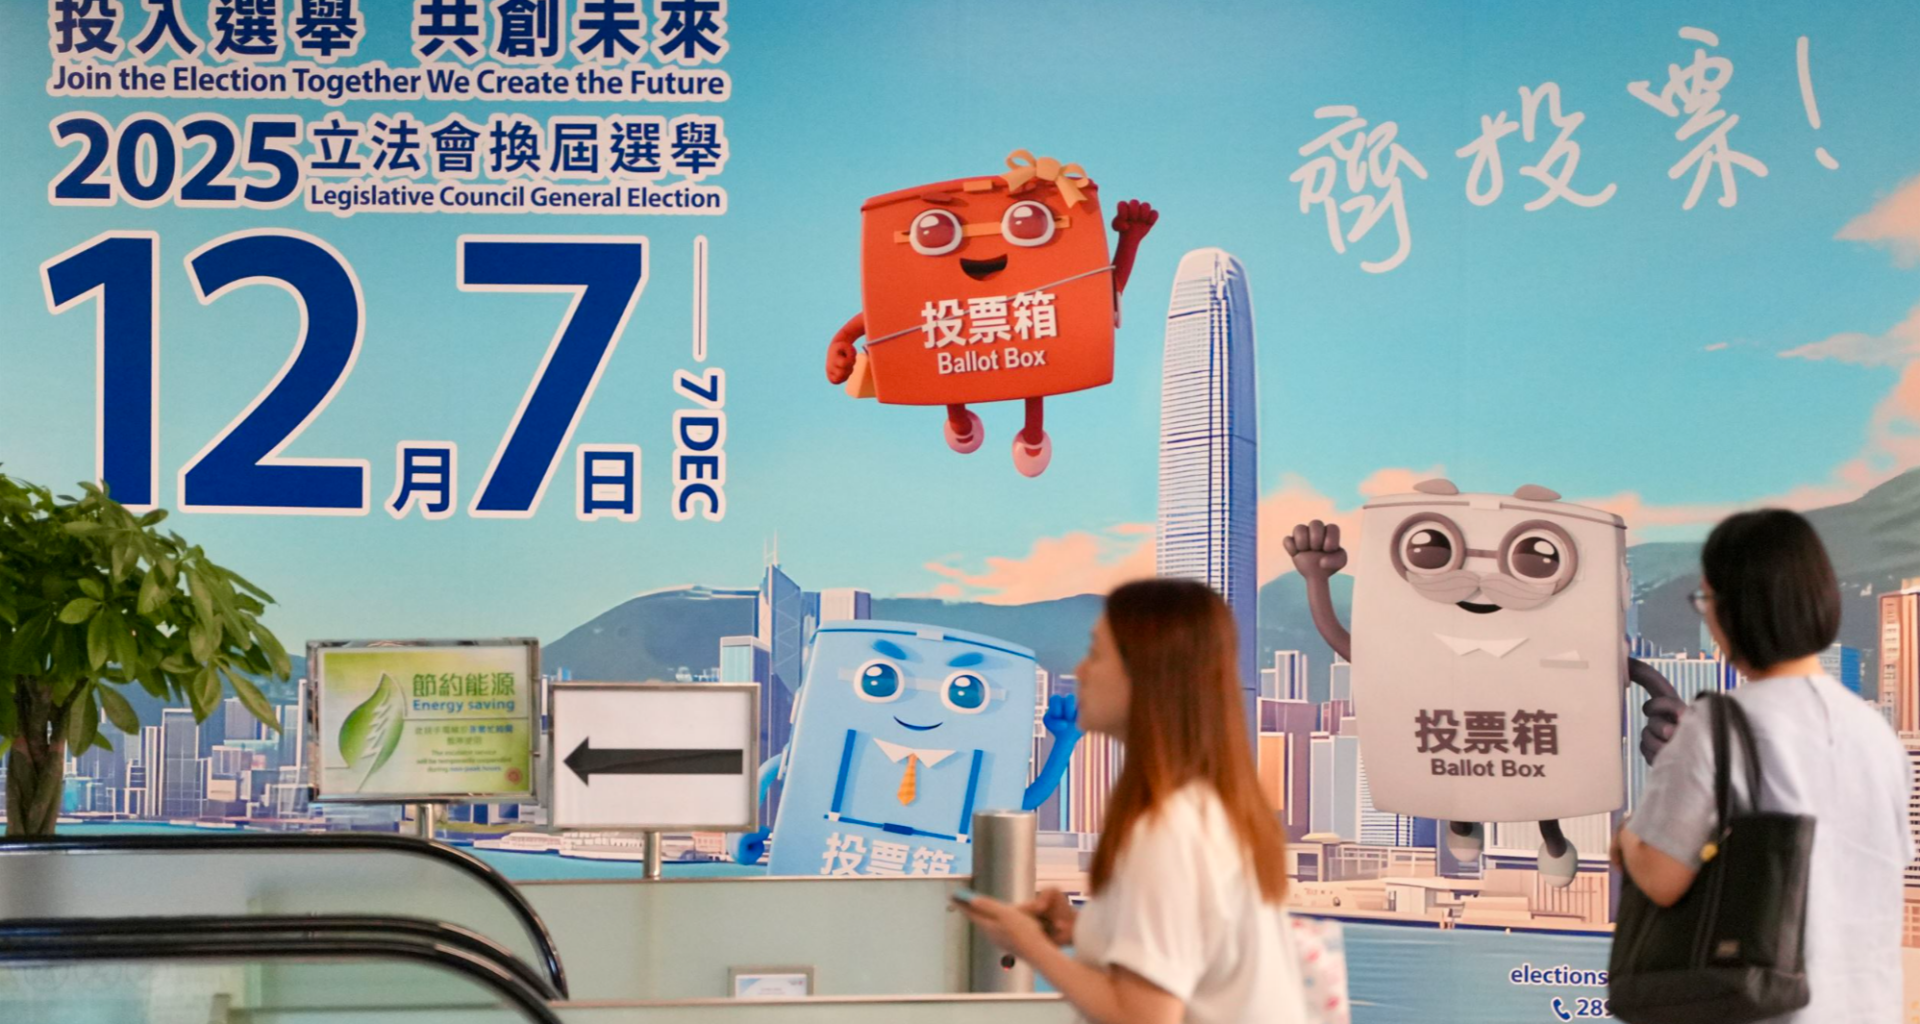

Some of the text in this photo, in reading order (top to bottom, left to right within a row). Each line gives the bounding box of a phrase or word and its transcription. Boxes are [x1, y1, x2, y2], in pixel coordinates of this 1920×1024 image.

[55, 0, 722, 58] 投入選舉 共創未來
[53, 65, 725, 99] Join the Election Together We Create the Future
[54, 117, 722, 203] 2025 立法會換屆選舉
[310, 185, 721, 210] Legislative Council General Election
[921, 290, 1058, 348] 投票箱
[937, 347, 1047, 375] Ballot Box
[679, 374, 720, 516] 7 DEC
[412, 672, 516, 697] 節約能源
[412, 698, 516, 713] Energy saving
[1414, 708, 1559, 756] 投票箱
[1430, 758, 1547, 778] Ballot Box
[1510, 964, 1609, 985] elections
